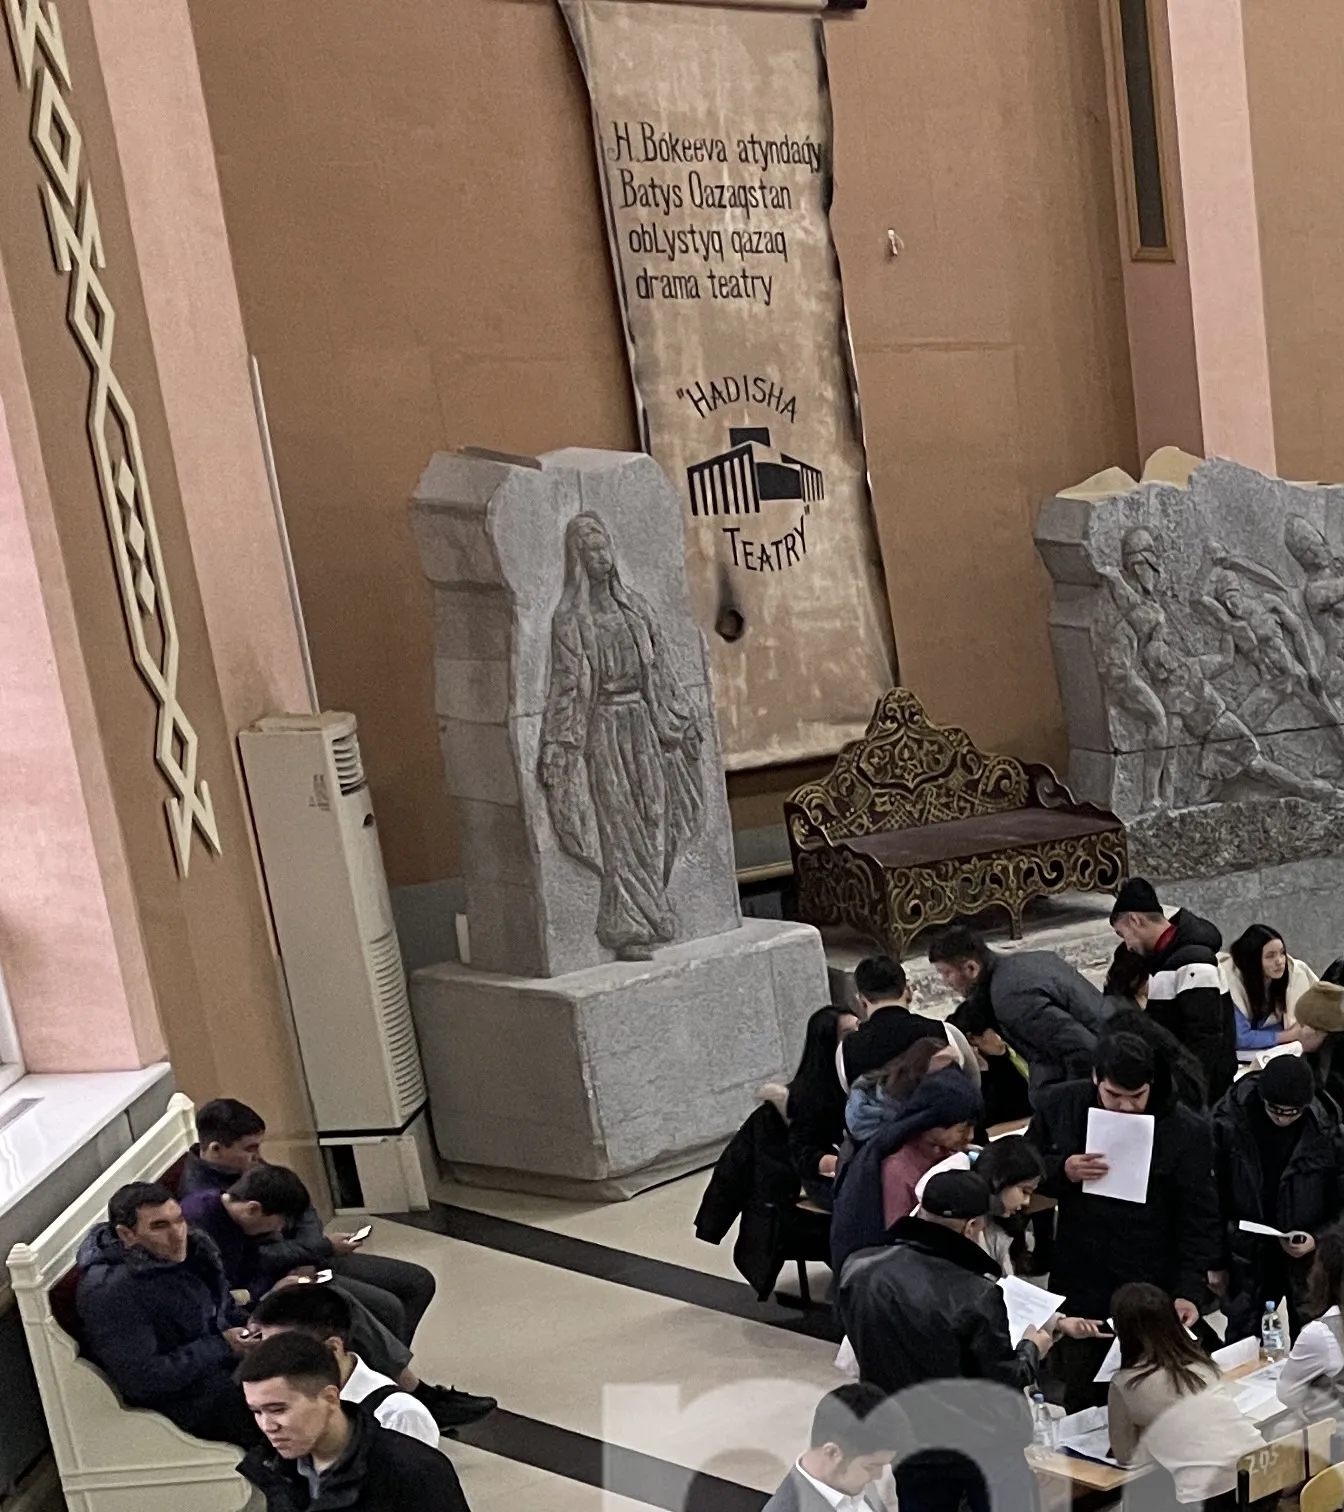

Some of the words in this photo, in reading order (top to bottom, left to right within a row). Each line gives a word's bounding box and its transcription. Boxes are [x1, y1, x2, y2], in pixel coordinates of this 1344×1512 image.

[617, 168, 684, 216] Batys
[688, 170, 793, 219] Qazaqstan
[731, 230, 788, 263] qazaq
[635, 267, 702, 300] drama
[707, 268, 773, 307] teatry
